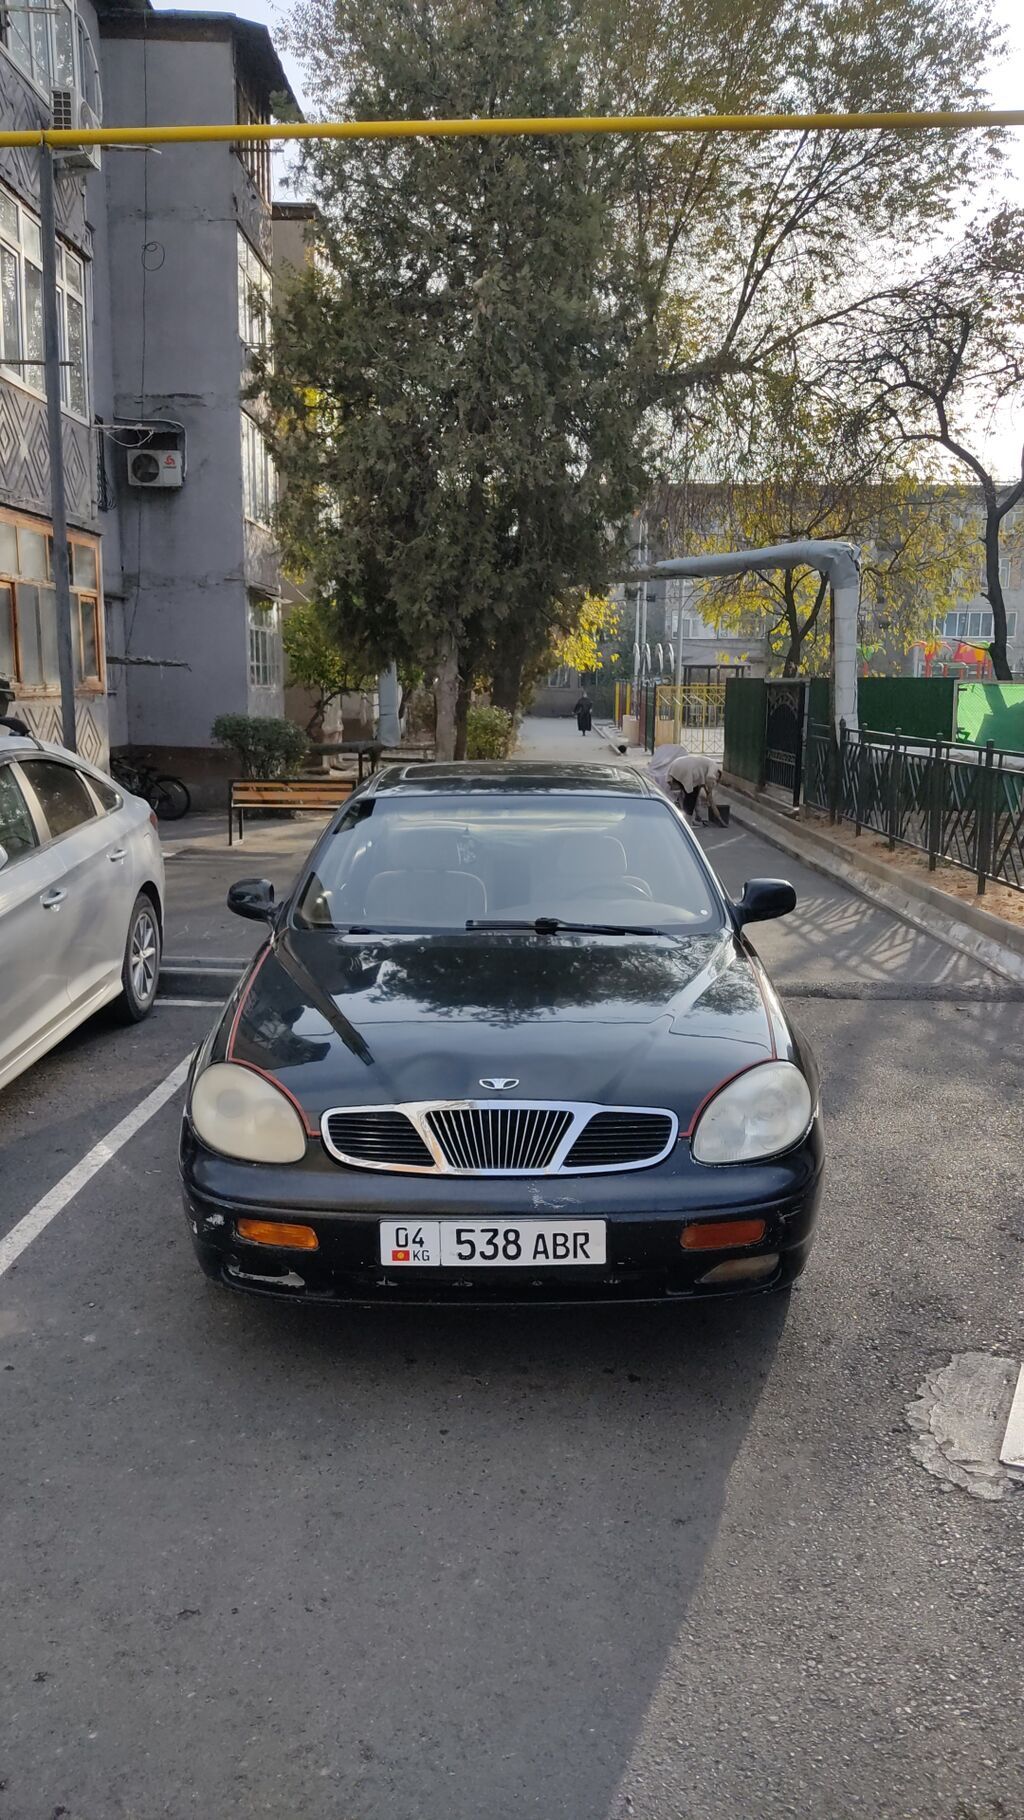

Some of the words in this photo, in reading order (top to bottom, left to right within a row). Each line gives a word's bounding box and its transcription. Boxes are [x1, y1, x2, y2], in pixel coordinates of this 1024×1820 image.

[395, 1227, 425, 1248] 04
[455, 1228, 522, 1261] 538
[532, 1232, 591, 1260] ABR
[412, 1250, 430, 1261] KG
